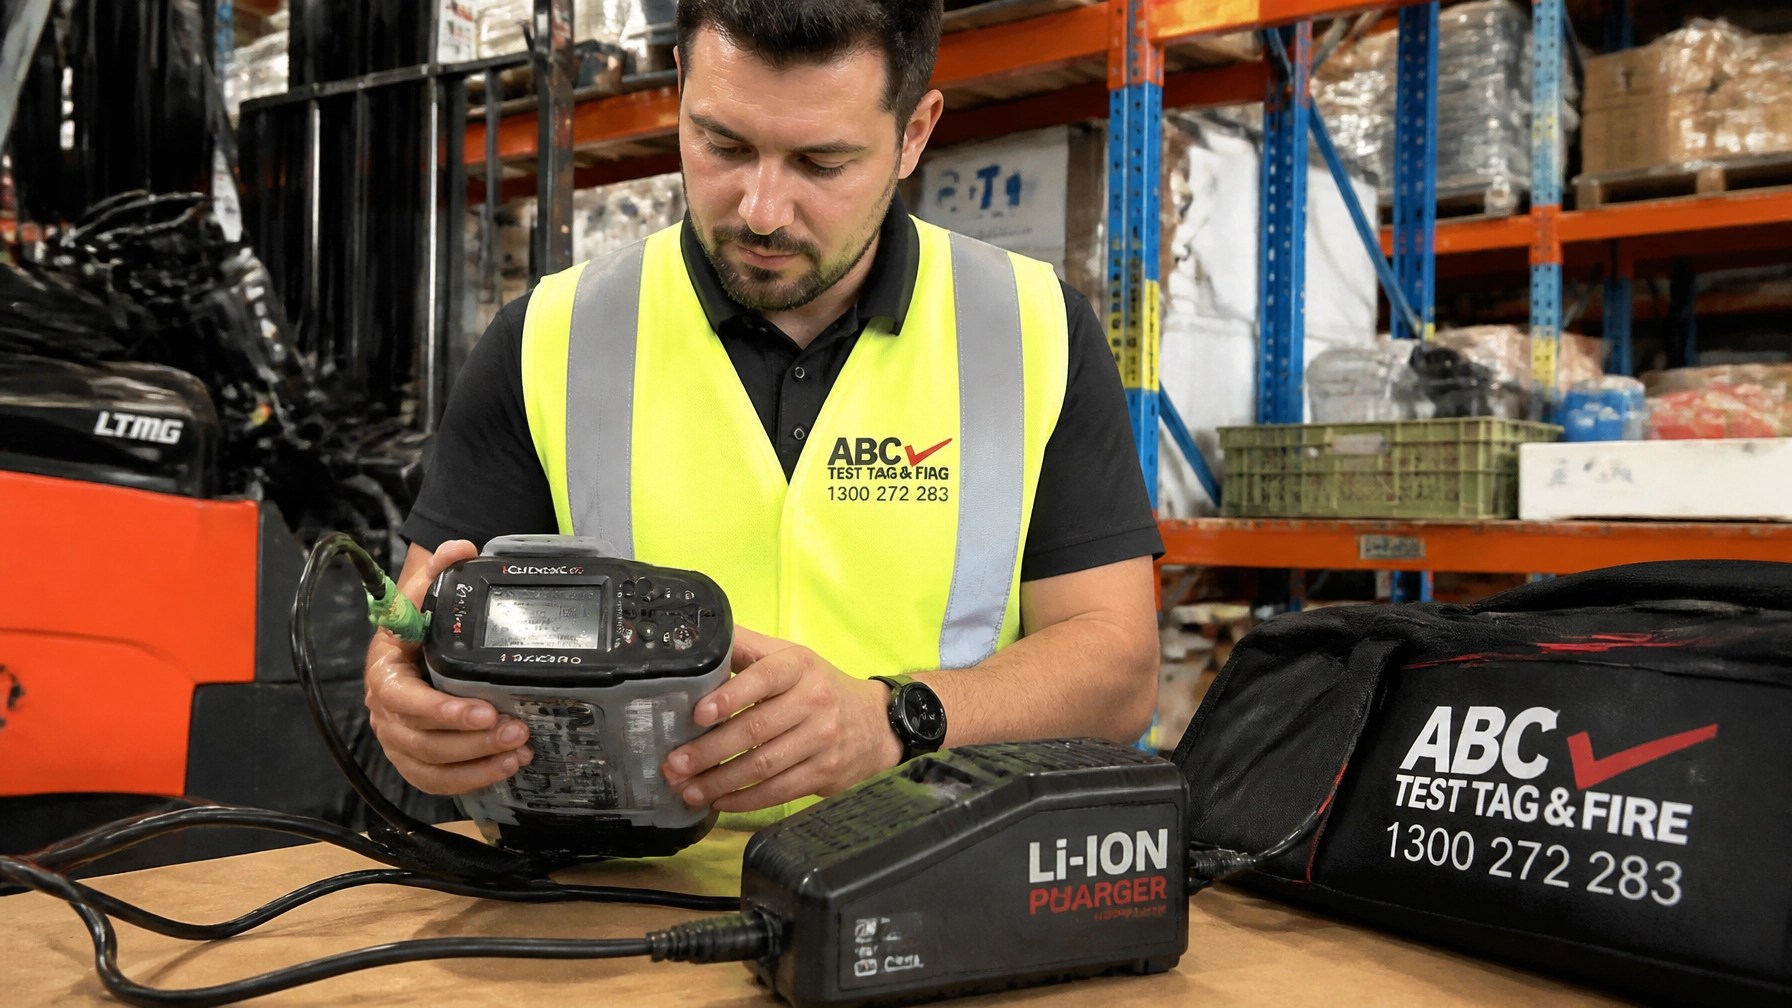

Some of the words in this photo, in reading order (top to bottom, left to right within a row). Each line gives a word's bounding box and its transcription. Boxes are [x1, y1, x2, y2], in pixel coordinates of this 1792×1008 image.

[93, 410, 184, 445] LTMG
[827, 436, 902, 466] ABC
[827, 466, 863, 480] TEST
[866, 466, 898, 480] TAG
[899, 465, 913, 480] &
[827, 486, 870, 502] 1300
[876, 485, 909, 502] 272
[916, 485, 949, 502] 283
[1398, 705, 1561, 780] ABC
[1395, 773, 1468, 813] TEST
[1471, 780, 1540, 823] TAG
[1543, 786, 1577, 828] &
[1581, 790, 1694, 845] FIRE
[1028, 828, 1168, 884] Li-ION
[1386, 821, 1476, 871] 1300
[1488, 836, 1571, 888] 272
[1586, 850, 1683, 906] 283
